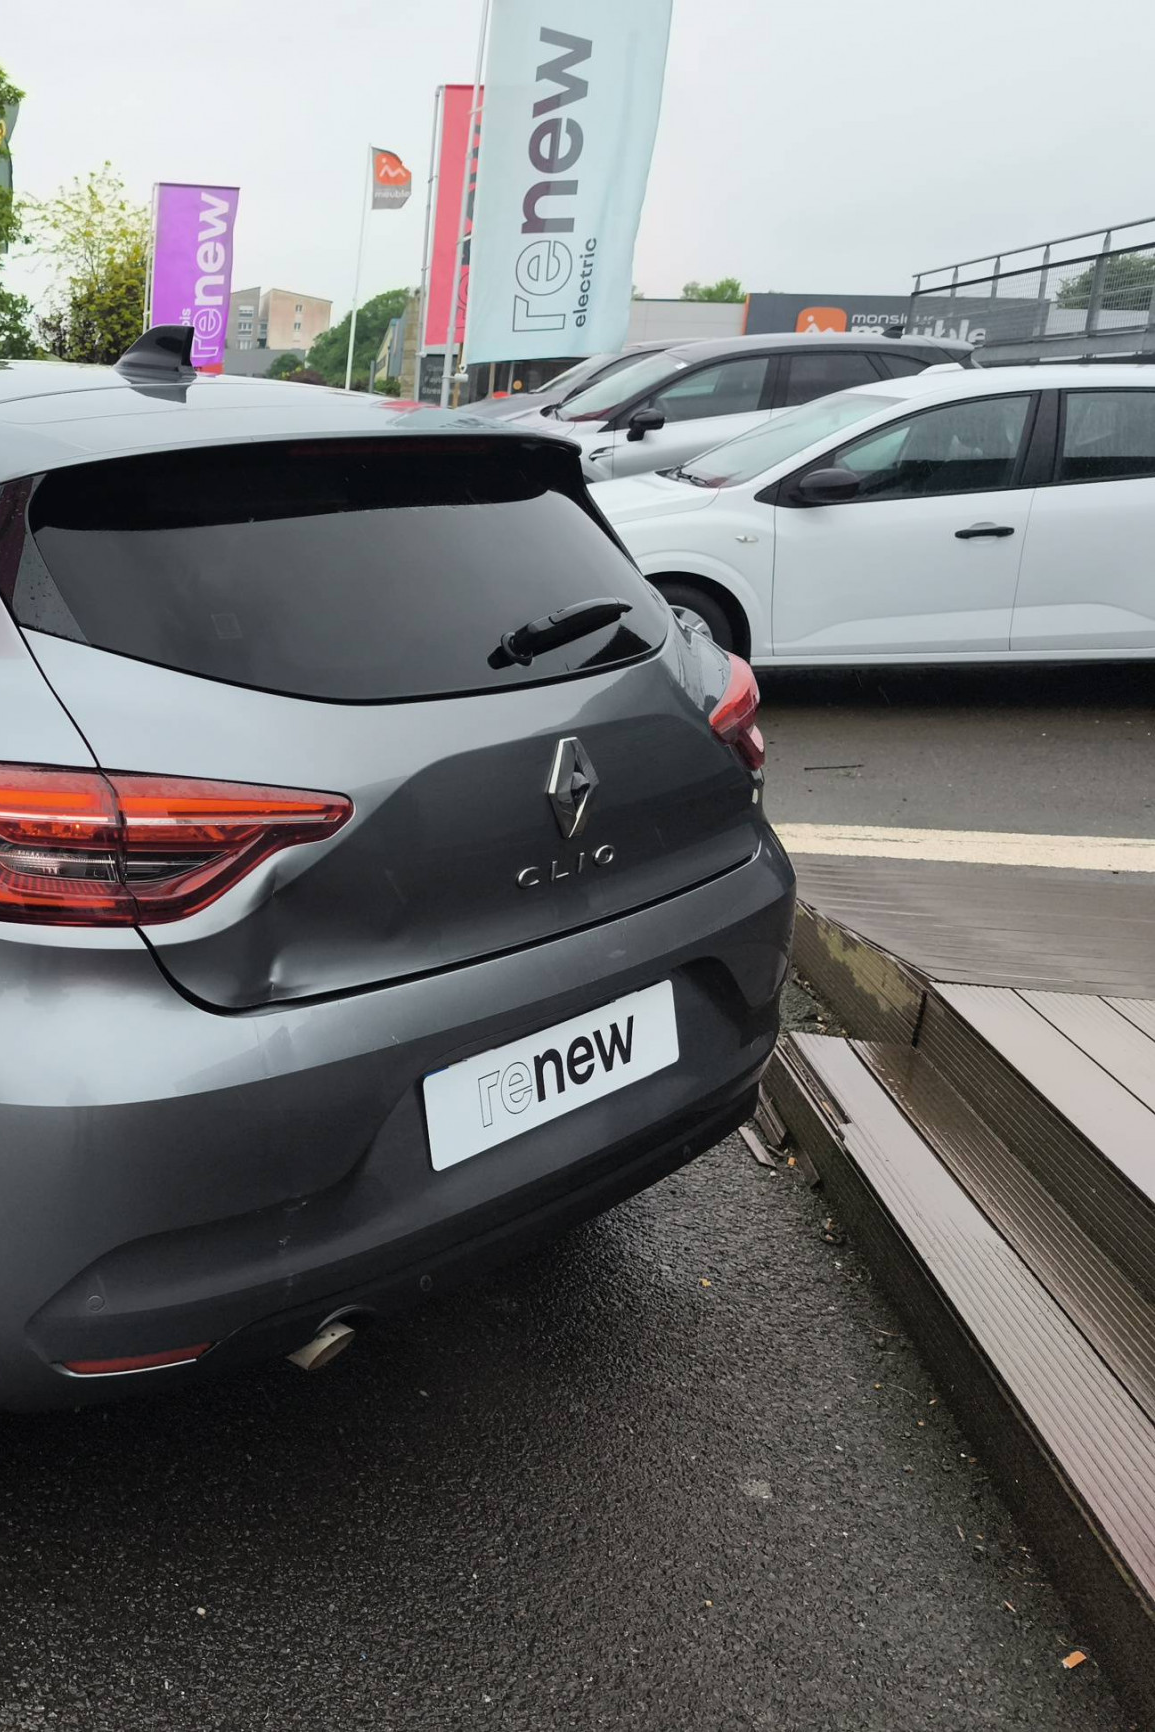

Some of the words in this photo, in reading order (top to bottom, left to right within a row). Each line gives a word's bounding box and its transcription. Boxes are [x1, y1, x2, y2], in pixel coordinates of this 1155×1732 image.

[512, 26, 593, 332] renew
[192, 191, 230, 358] renew
[572, 237, 597, 328] electric
[515, 844, 615, 889] CLIO
[477, 1015, 634, 1128] renew
